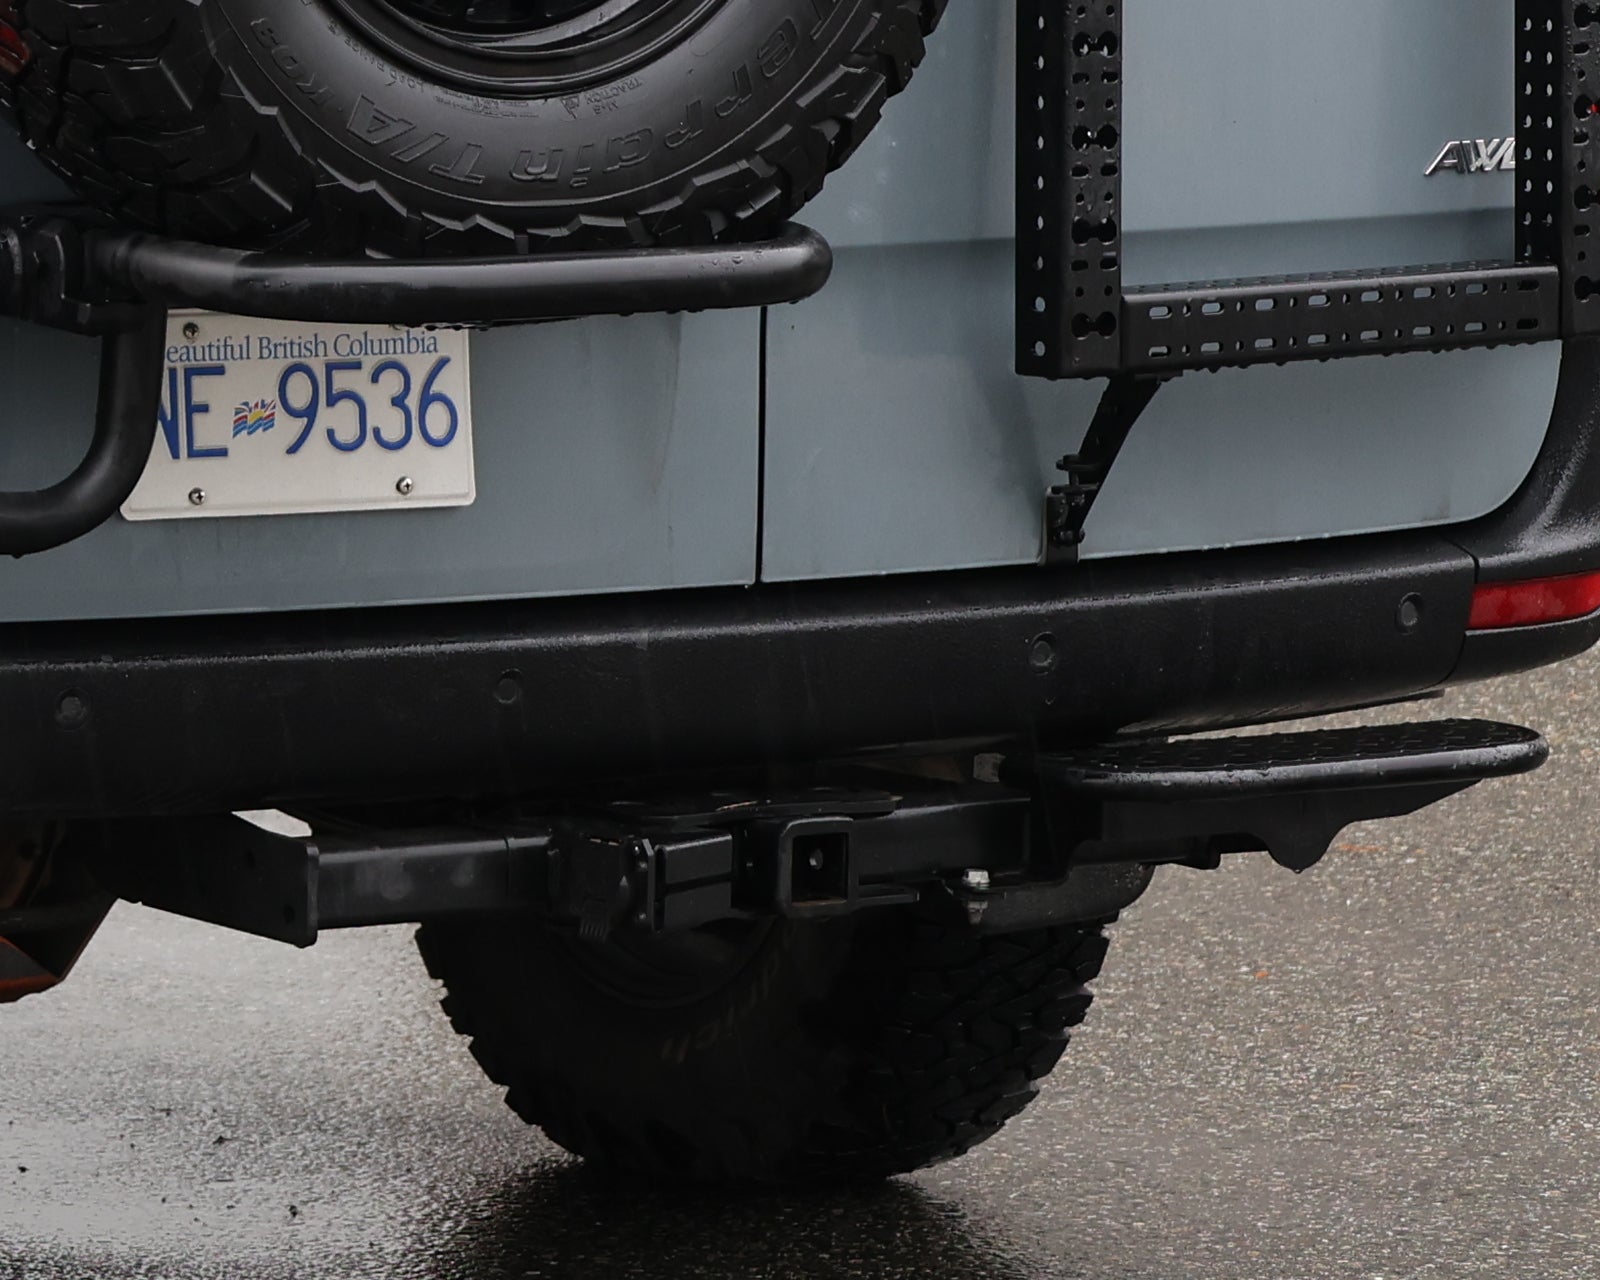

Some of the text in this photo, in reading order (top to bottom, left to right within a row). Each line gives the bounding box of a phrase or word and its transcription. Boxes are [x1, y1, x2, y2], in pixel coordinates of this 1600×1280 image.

[165, 332, 438, 363] eautiful British Columbia
[277, 355, 459, 456] 9536
